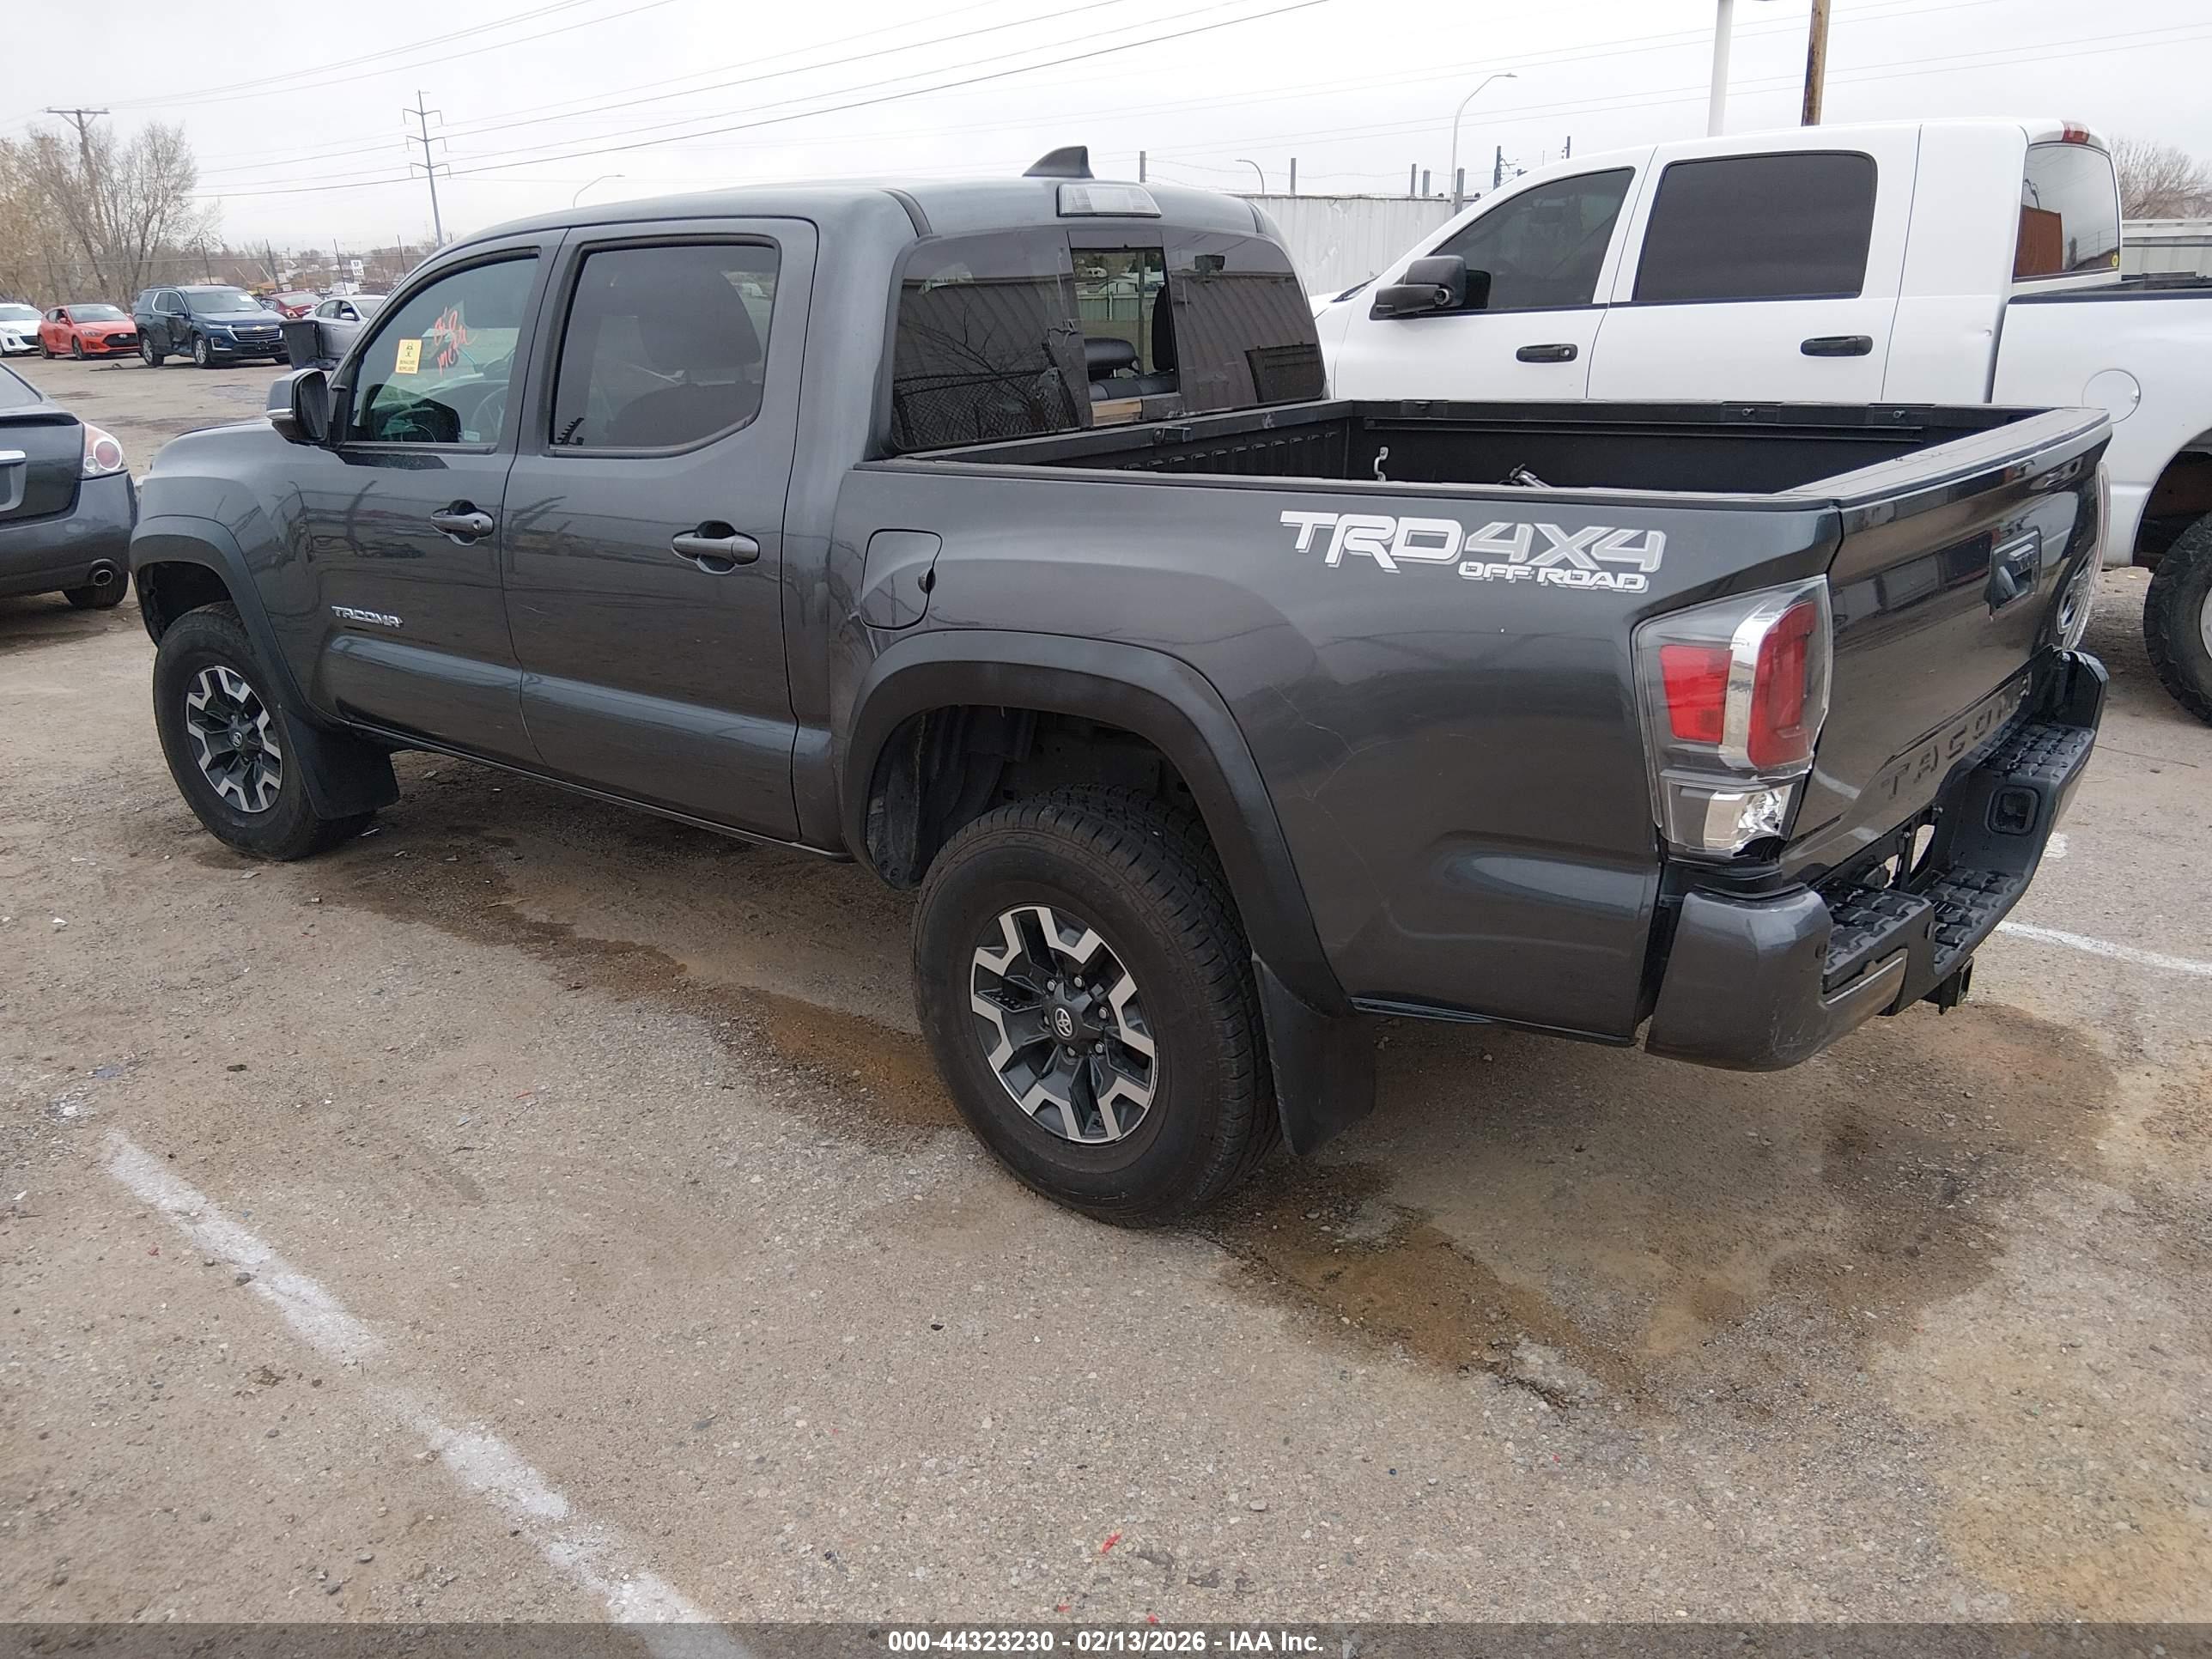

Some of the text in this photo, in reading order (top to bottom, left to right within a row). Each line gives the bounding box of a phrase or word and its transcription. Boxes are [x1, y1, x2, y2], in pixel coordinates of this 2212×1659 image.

[1280, 510, 1667, 574] TRD 4X4
[1458, 561, 1649, 593] OFF ROAD
[331, 605, 404, 628] TACOMA
